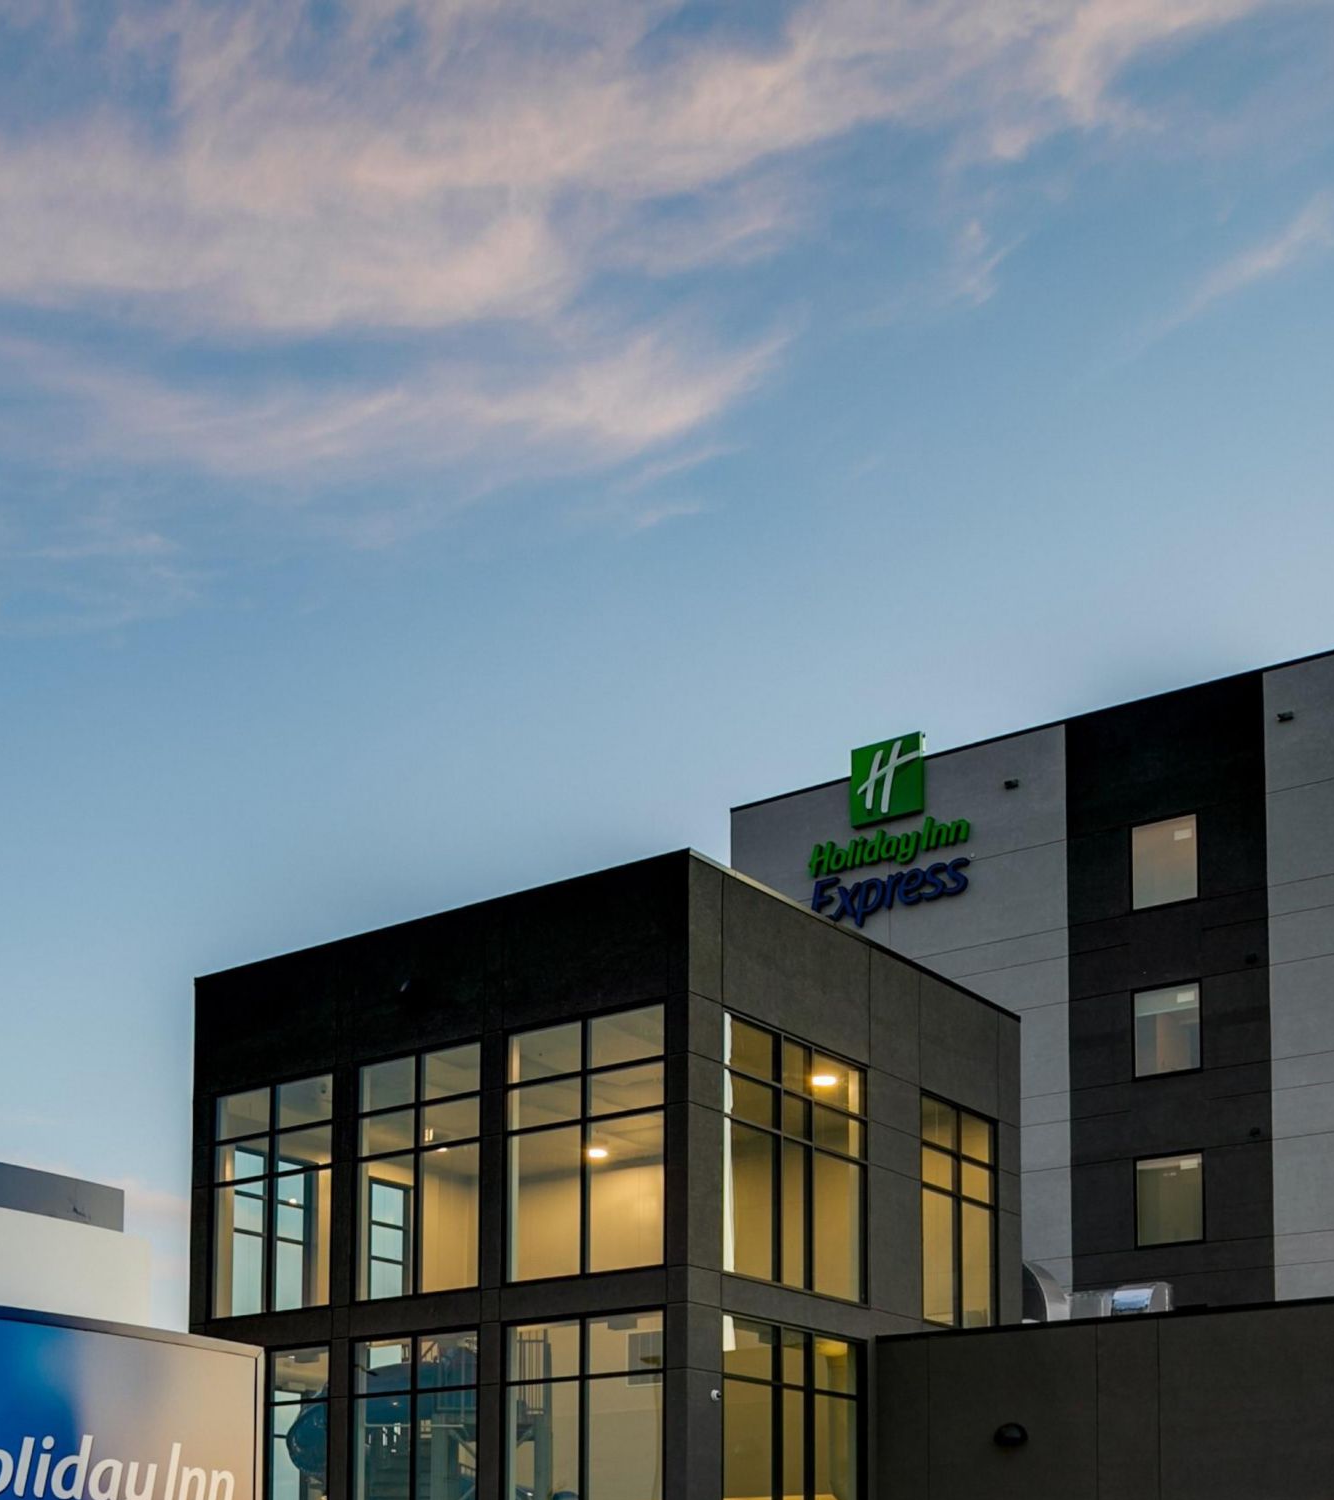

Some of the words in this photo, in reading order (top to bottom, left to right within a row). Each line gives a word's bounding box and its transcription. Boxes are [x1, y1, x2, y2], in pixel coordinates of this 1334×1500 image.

[808, 829, 919, 877] Holiday
[920, 816, 970, 852] Inn
[810, 857, 970, 928] Express
